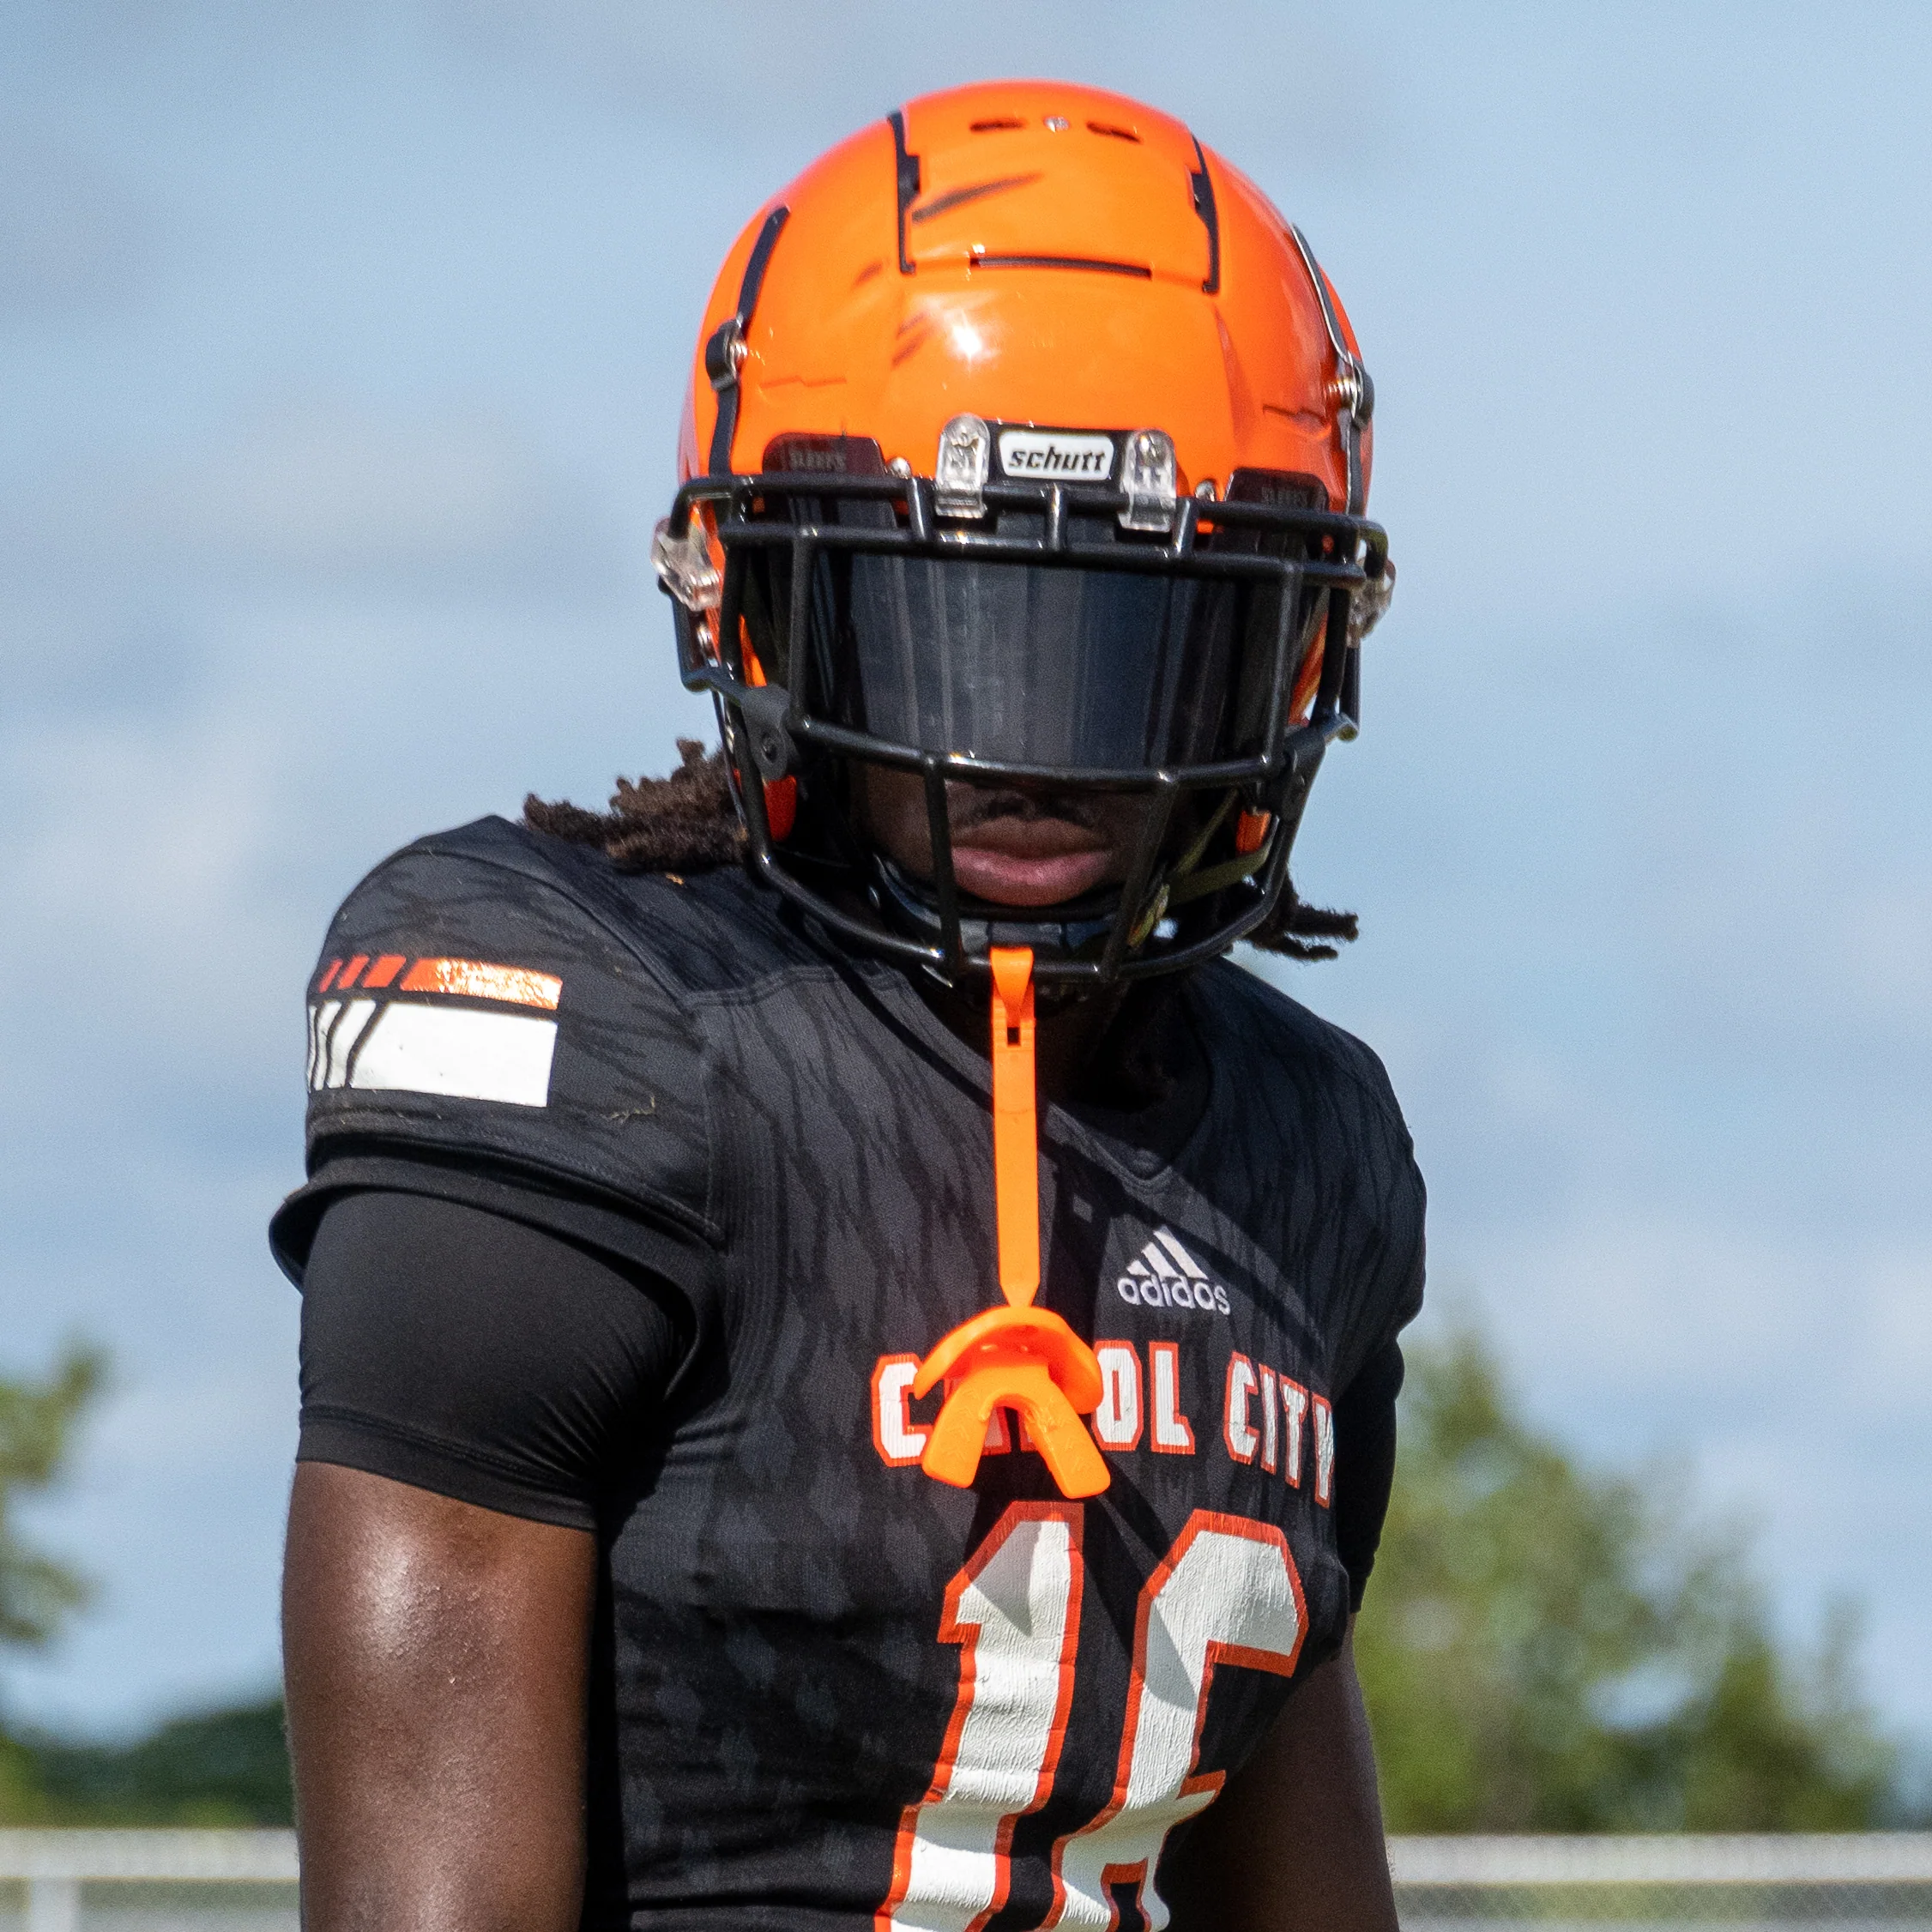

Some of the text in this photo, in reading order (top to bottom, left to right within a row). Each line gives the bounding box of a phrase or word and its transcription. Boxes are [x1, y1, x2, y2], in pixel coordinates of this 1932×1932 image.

[1008, 444, 1106, 473] schutt
[1117, 1274, 1231, 1315] adidas
[870, 1339, 1334, 1508] COL CITY
[873, 1500, 1308, 1932] 16
